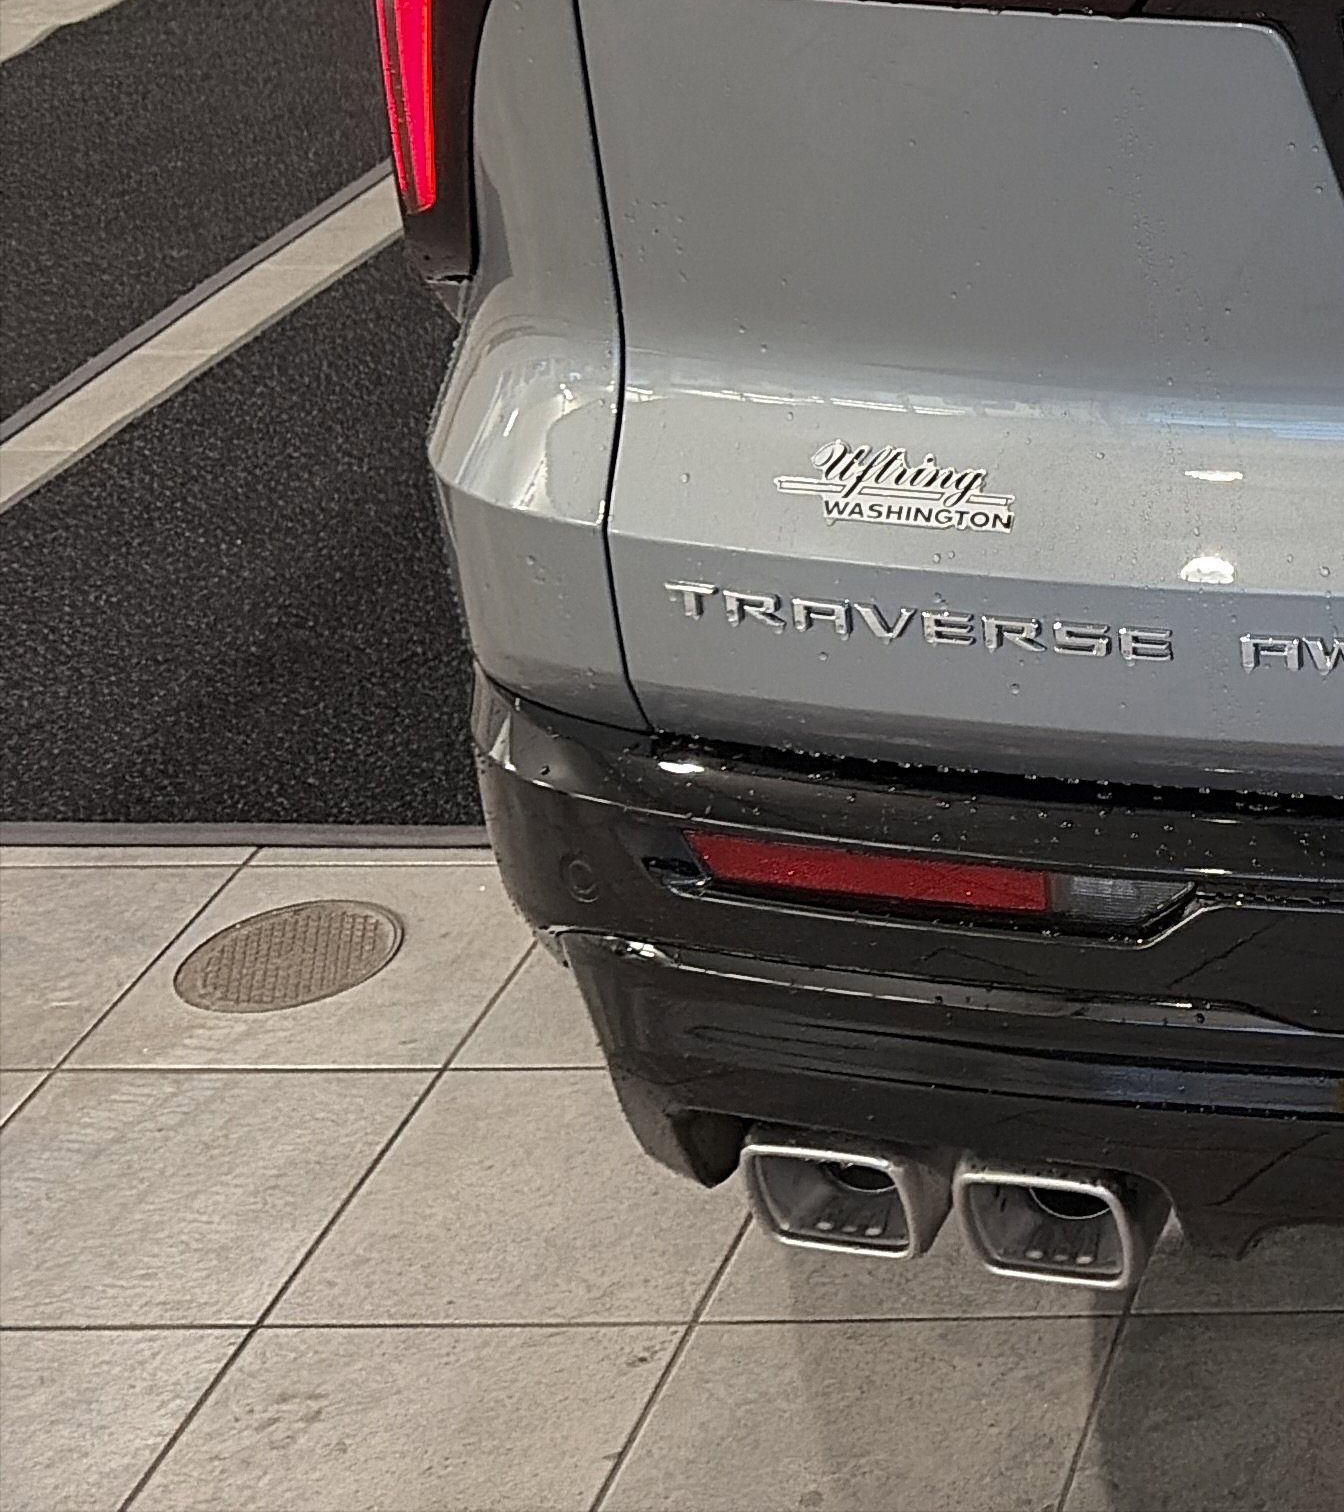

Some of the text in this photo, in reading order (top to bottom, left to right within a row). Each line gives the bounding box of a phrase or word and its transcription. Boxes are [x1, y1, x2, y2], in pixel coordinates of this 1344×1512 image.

[812, 441, 986, 508] Uftring
[824, 499, 1013, 530] WASHINGTON
[664, 580, 1175, 663] TRAVERSE
